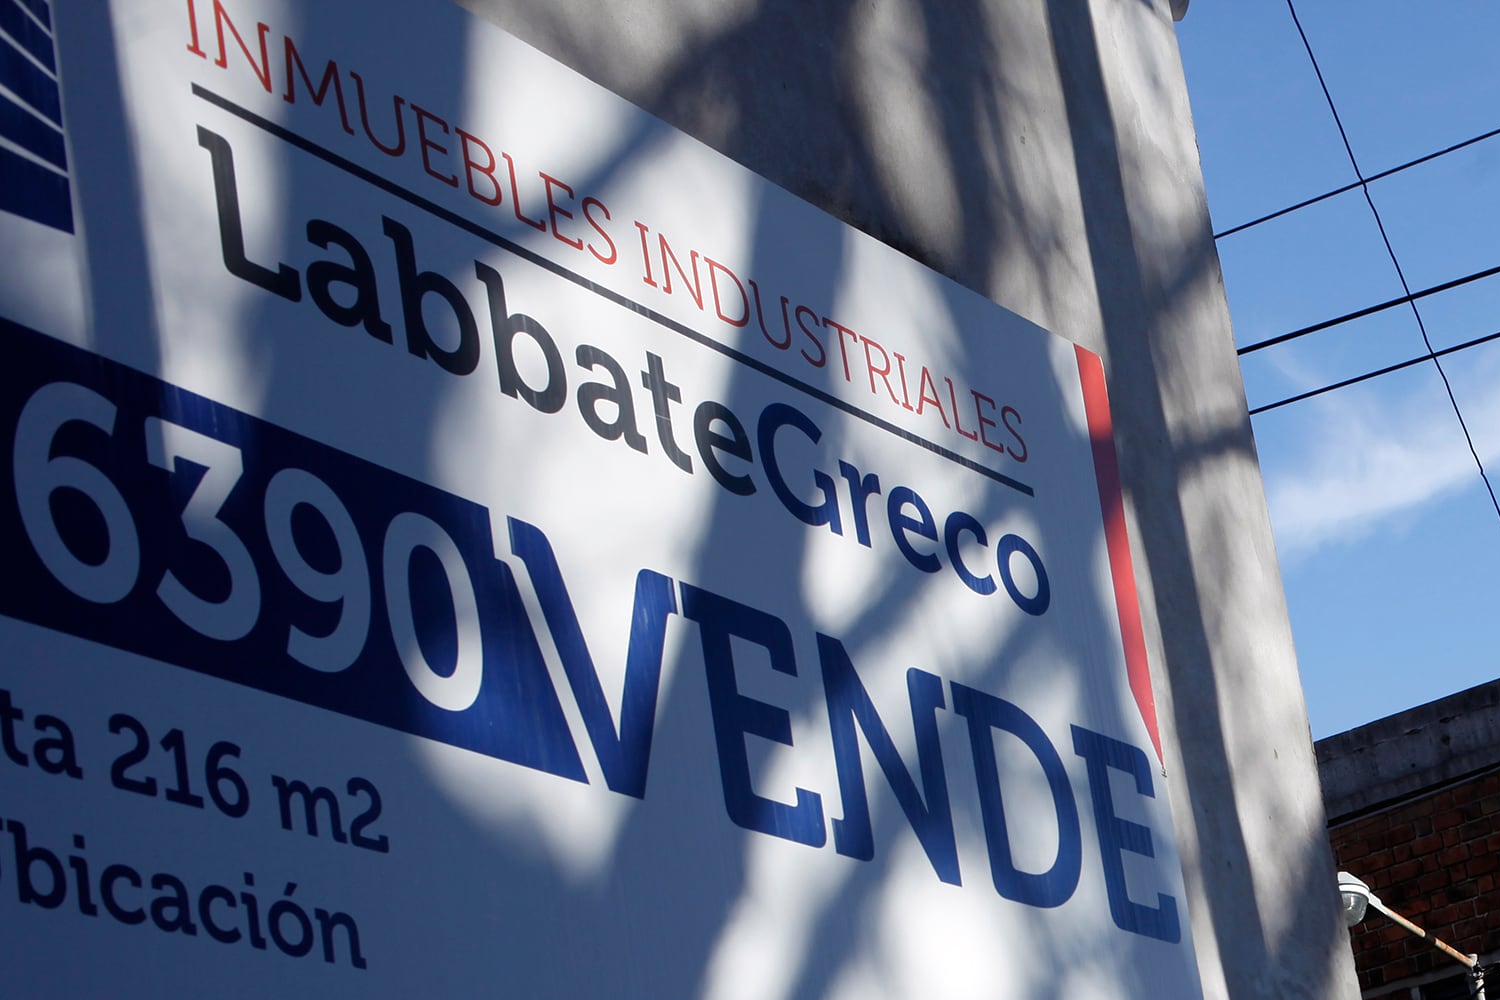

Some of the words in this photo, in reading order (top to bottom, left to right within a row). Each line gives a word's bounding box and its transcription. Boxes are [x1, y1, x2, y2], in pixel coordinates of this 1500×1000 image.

[186, 0, 618, 265] INMUEBLES
[196, 124, 1051, 617] LabbateGreco
[634, 220, 1029, 463] INDUSTRIALES
[13, 381, 485, 712] 6390
[108, 713, 250, 819] 216
[272, 778, 390, 853] m2
[506, 514, 1181, 945] VENDE
[0, 817, 367, 970] bicación
